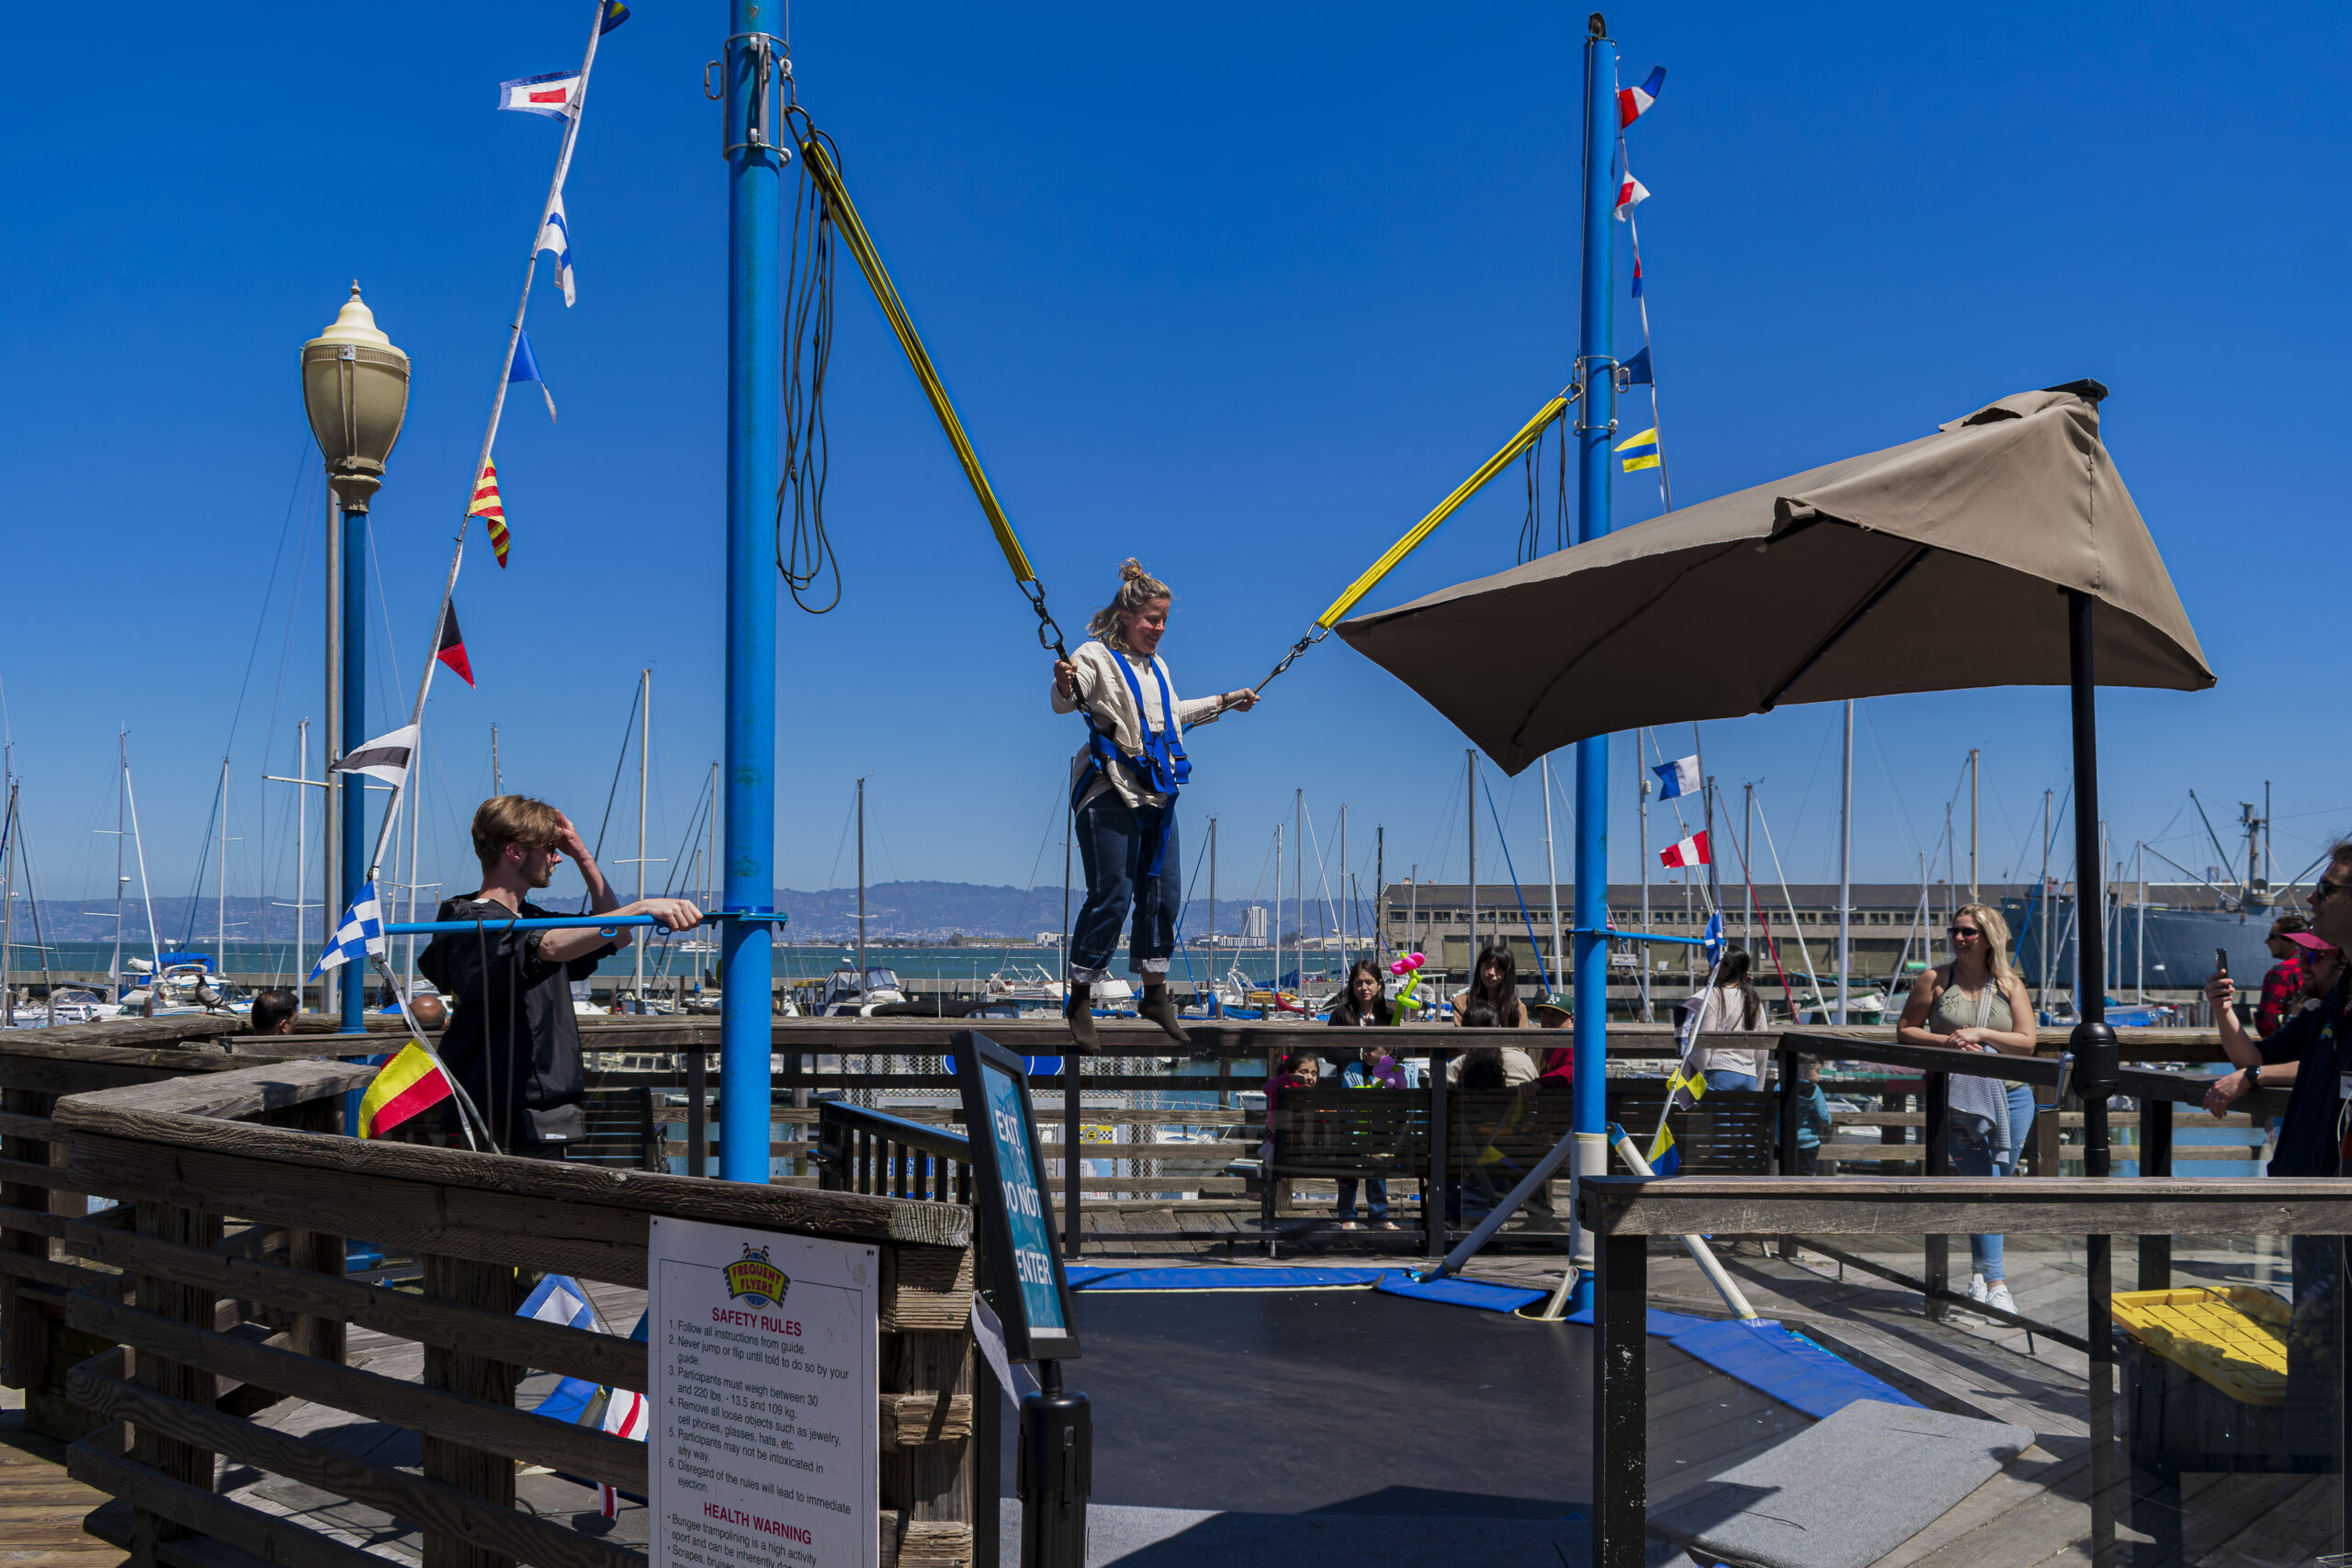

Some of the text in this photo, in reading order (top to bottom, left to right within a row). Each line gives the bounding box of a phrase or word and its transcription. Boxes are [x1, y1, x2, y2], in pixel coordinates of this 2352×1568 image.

[995, 1110, 1021, 1146] EXIT
[1017, 1183, 1041, 1218] NOT
[732, 1264, 782, 1285] FREQUENT
[1014, 1249, 1052, 1285] ENTER
[741, 1279, 774, 1295] FLYERS
[670, 1319, 807, 1355] 1. Follow all instructions from guide.
[712, 1307, 801, 1336] SAFETY RULES
[669, 1334, 849, 1380] 2. Never jump or flip until told to do so by your
[678, 1354, 700, 1365] guide.
[669, 1365, 819, 1407] 3. Participants must weigh between 30
[678, 1384, 692, 1394] and
[694, 1386, 708, 1398] 220
[710, 1390, 723, 1402] lbs.
[731, 1394, 748, 1407] 13.5
[751, 1401, 765, 1411] and
[768, 1404, 783, 1416] 109
[786, 1406, 797, 1421] kg.
[669, 1396, 841, 1447] 4. Remove all loose objects such as jewelry,
[678, 1416, 796, 1450] cell phones, glasses, hats, etc.
[669, 1427, 824, 1474] 5. Participants may not be intoxicated in
[678, 1446, 710, 1463] any way.
[669, 1457, 851, 1514] 6. Disregard of the rules will lead to immediate
[678, 1477, 709, 1492] ejection.
[673, 1514, 701, 1531] Bungee
[703, 1524, 750, 1548] trampolining
[752, 1537, 759, 1549] is
[761, 1541, 766, 1551] a
[768, 1541, 786, 1557] high
[788, 1550, 817, 1566] activity
[704, 1503, 812, 1545] HEALTH WARNING
[672, 1531, 690, 1543] sport
[693, 1538, 706, 1548] and
[708, 1541, 722, 1552] can
[725, 1545, 734, 1556] be
[737, 1548, 775, 1568] inherently
[673, 1544, 705, 1564] Scrapes,
